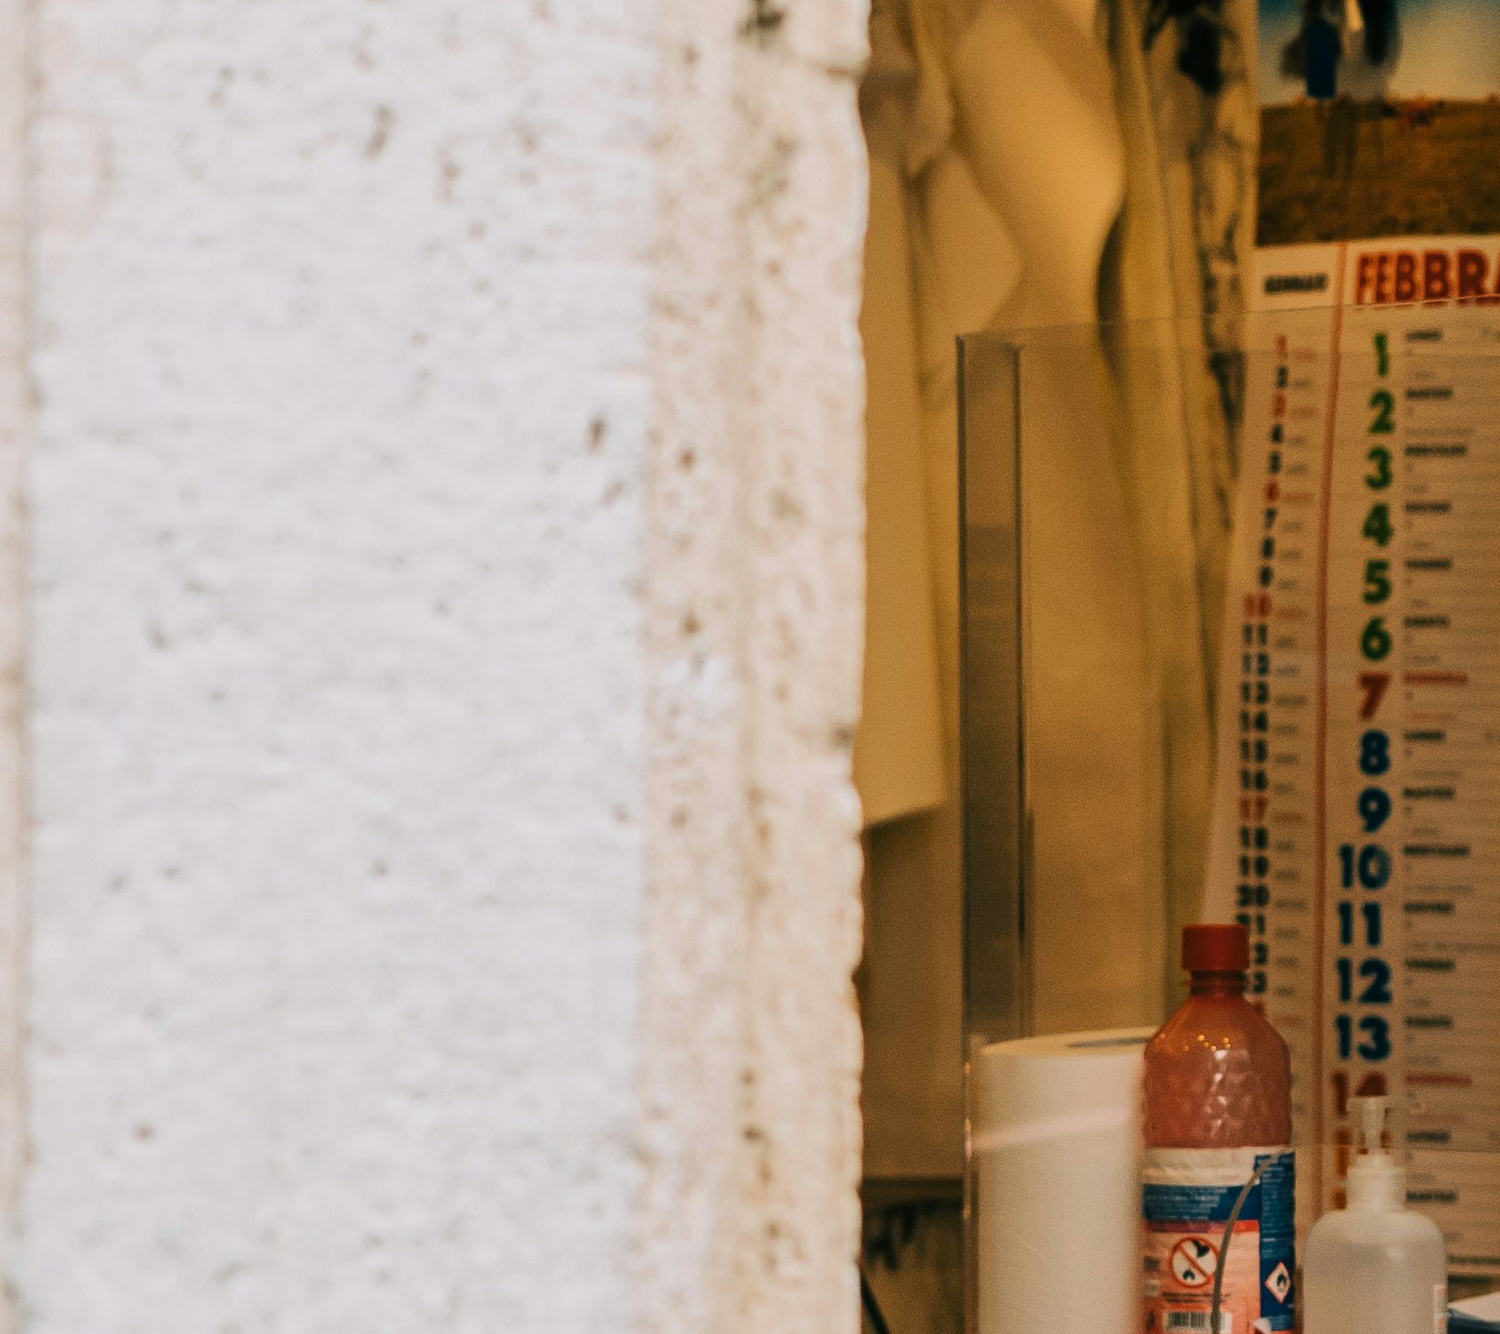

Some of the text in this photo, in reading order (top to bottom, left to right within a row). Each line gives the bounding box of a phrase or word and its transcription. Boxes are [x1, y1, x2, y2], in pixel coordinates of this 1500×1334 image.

[1373, 331, 1390, 376] 1
[1368, 389, 1395, 435] 2
[1365, 446, 1393, 490] 3
[1362, 502, 1394, 547] 4
[1362, 559, 1392, 604] 5
[1360, 617, 1392, 661] 6
[1357, 671, 1392, 721] 7
[1359, 730, 1392, 775] 8
[1358, 788, 1391, 832] 9
[1338, 843, 1392, 889] 10
[1338, 901, 1381, 946] 11
[1335, 958, 1393, 1004] 12
[1335, 1015, 1392, 1060] 13
